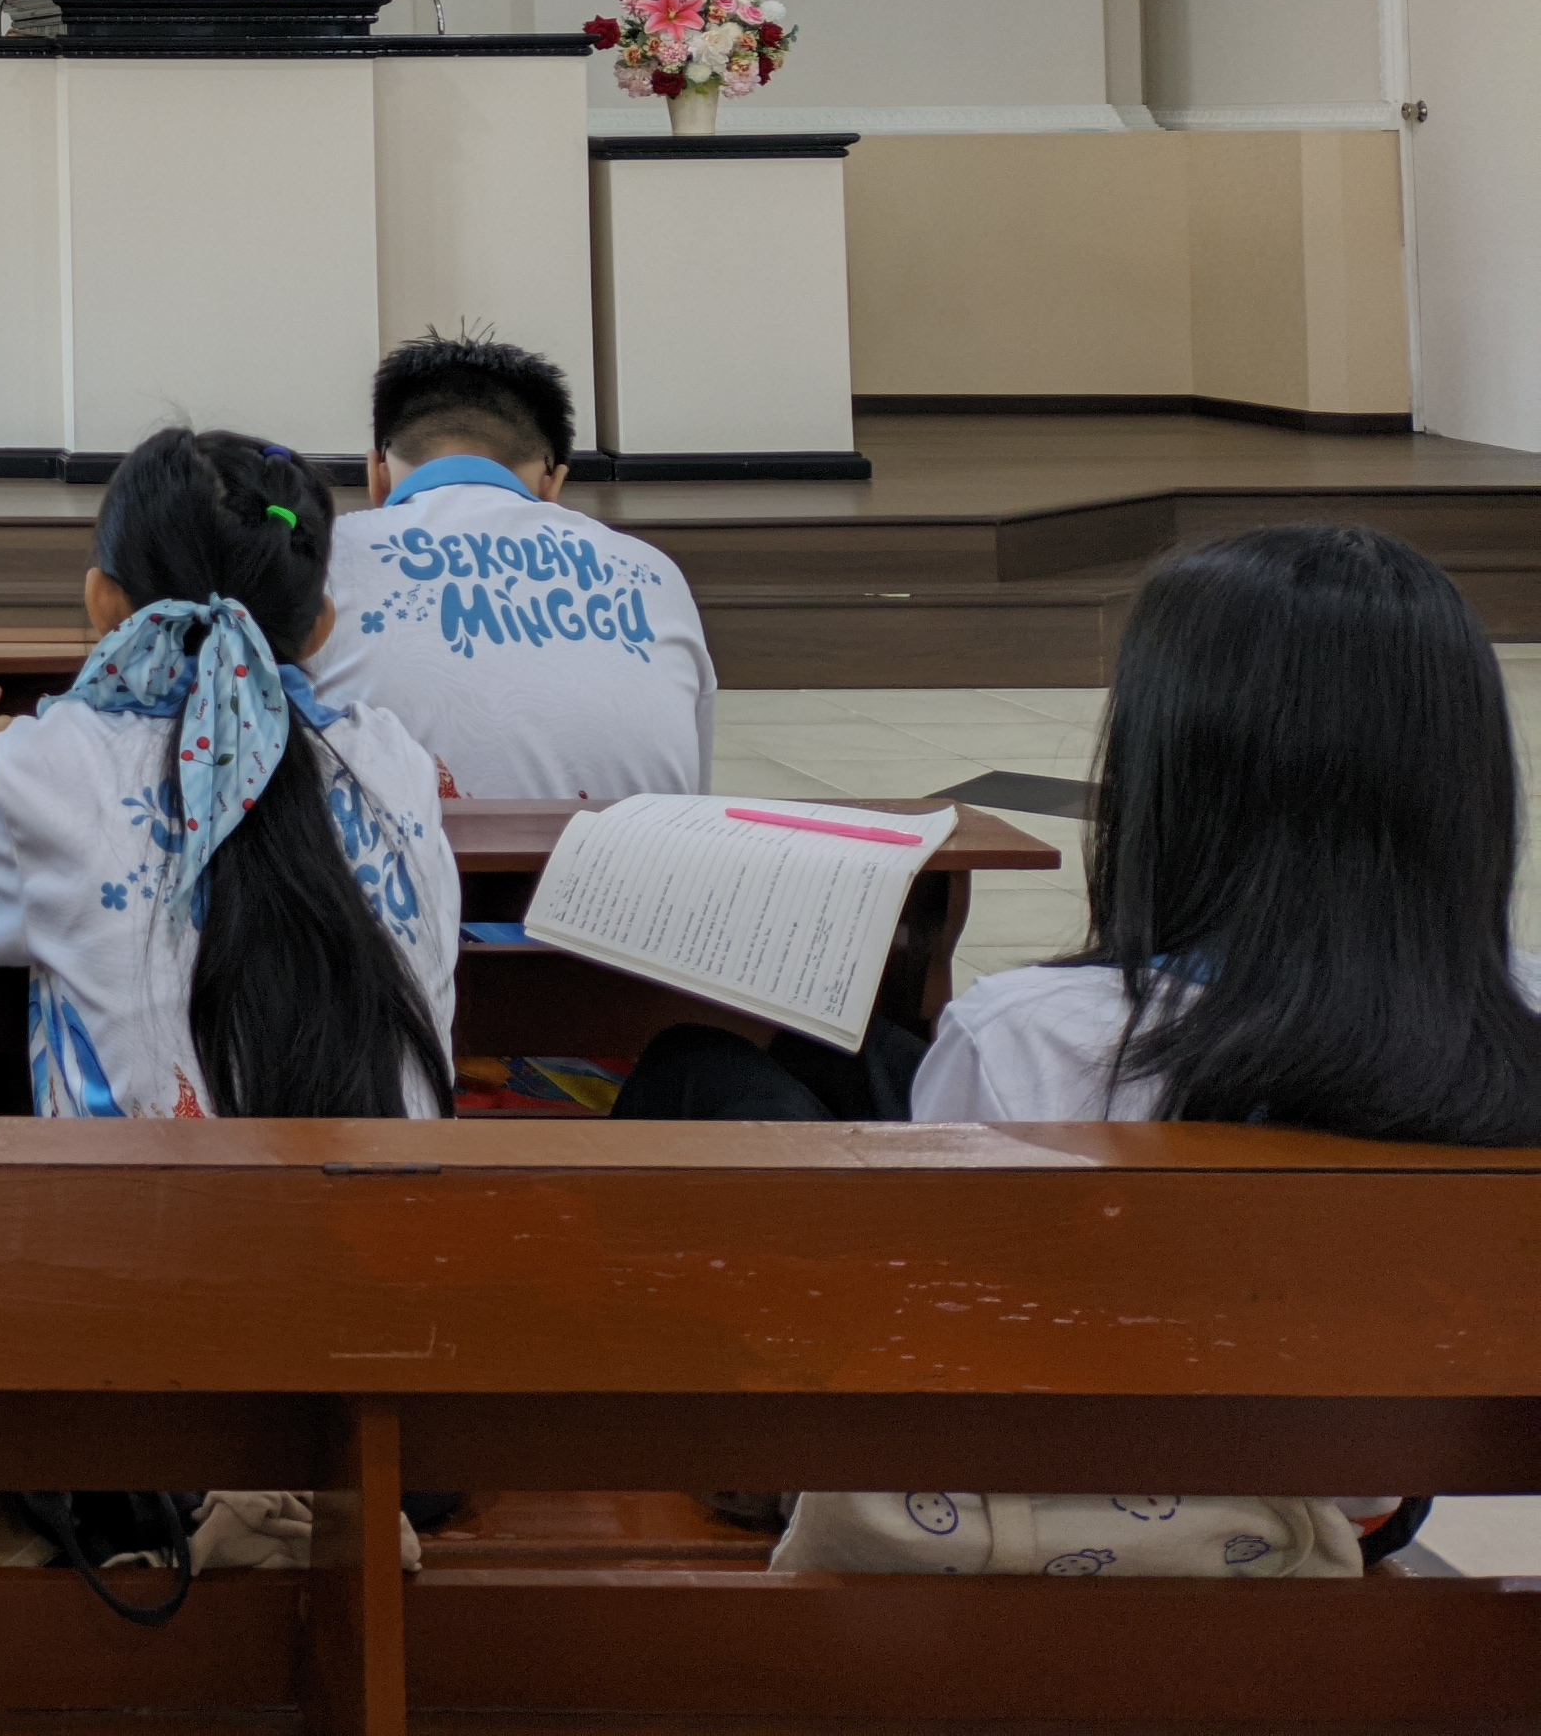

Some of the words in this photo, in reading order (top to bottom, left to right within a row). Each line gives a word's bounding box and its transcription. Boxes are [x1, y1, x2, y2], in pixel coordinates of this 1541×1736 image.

[399, 528, 604, 591] SEKOLAH
[440, 582, 655, 649] MINGGU
[195, 698, 208, 721] Cherry
[252, 751, 268, 774] Cherry
